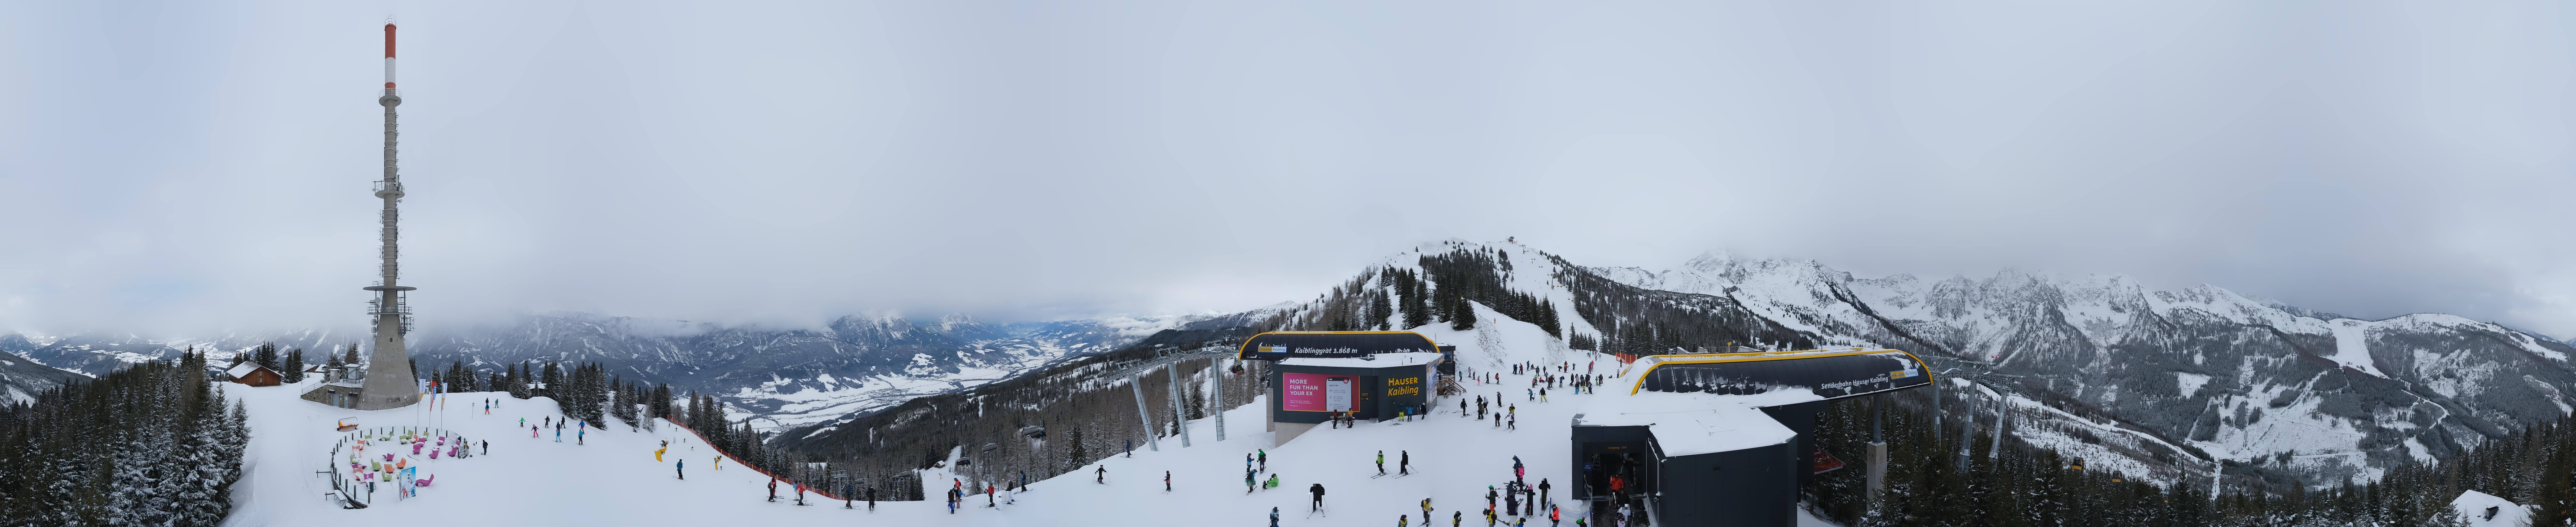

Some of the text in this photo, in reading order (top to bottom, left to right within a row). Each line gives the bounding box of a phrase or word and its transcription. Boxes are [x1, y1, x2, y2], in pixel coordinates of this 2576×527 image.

[1388, 377, 1418, 386] HAUSER
[1821, 380, 1852, 389] Senderbahn
[1388, 386, 1418, 396] Kaibling
